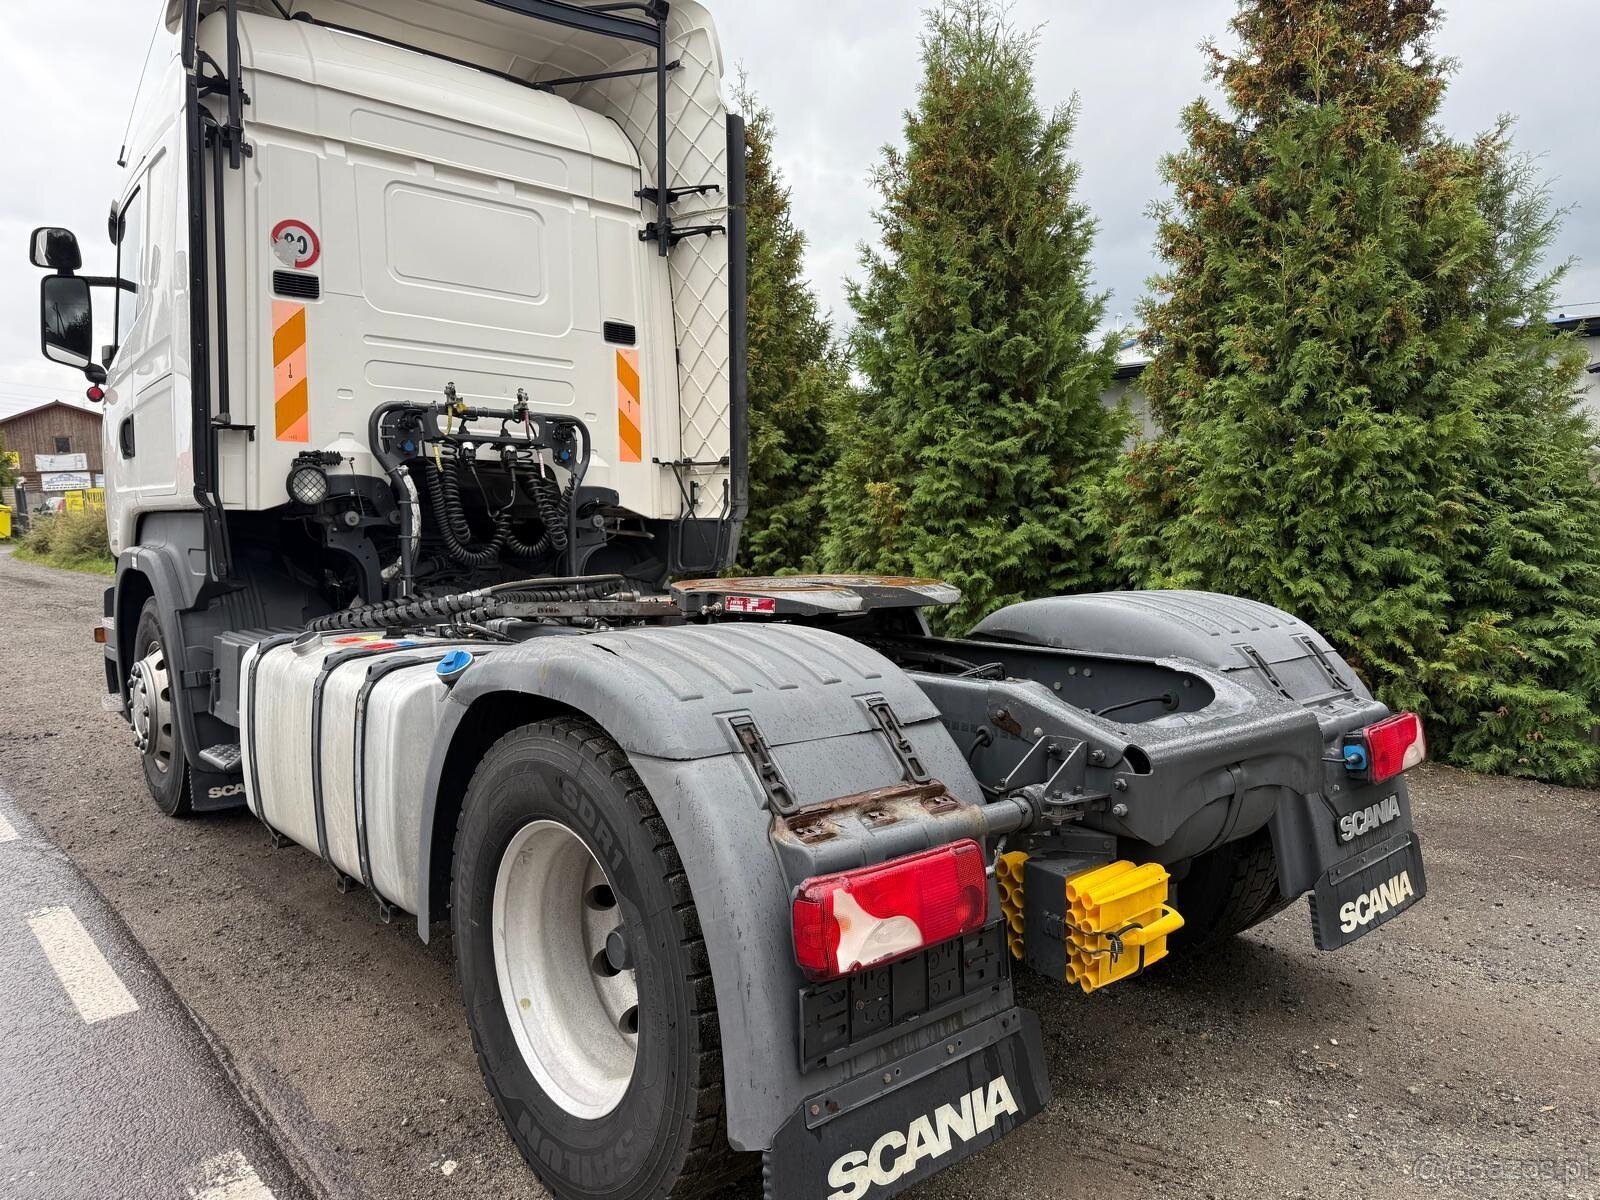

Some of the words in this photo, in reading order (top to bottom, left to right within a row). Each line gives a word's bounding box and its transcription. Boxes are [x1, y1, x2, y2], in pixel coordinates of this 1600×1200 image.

[560, 779, 626, 873] SDR1
[1340, 794, 1401, 842] SCANIA
[1339, 870, 1414, 934] SCANIA
[827, 1074, 1019, 1200] SCANIA
